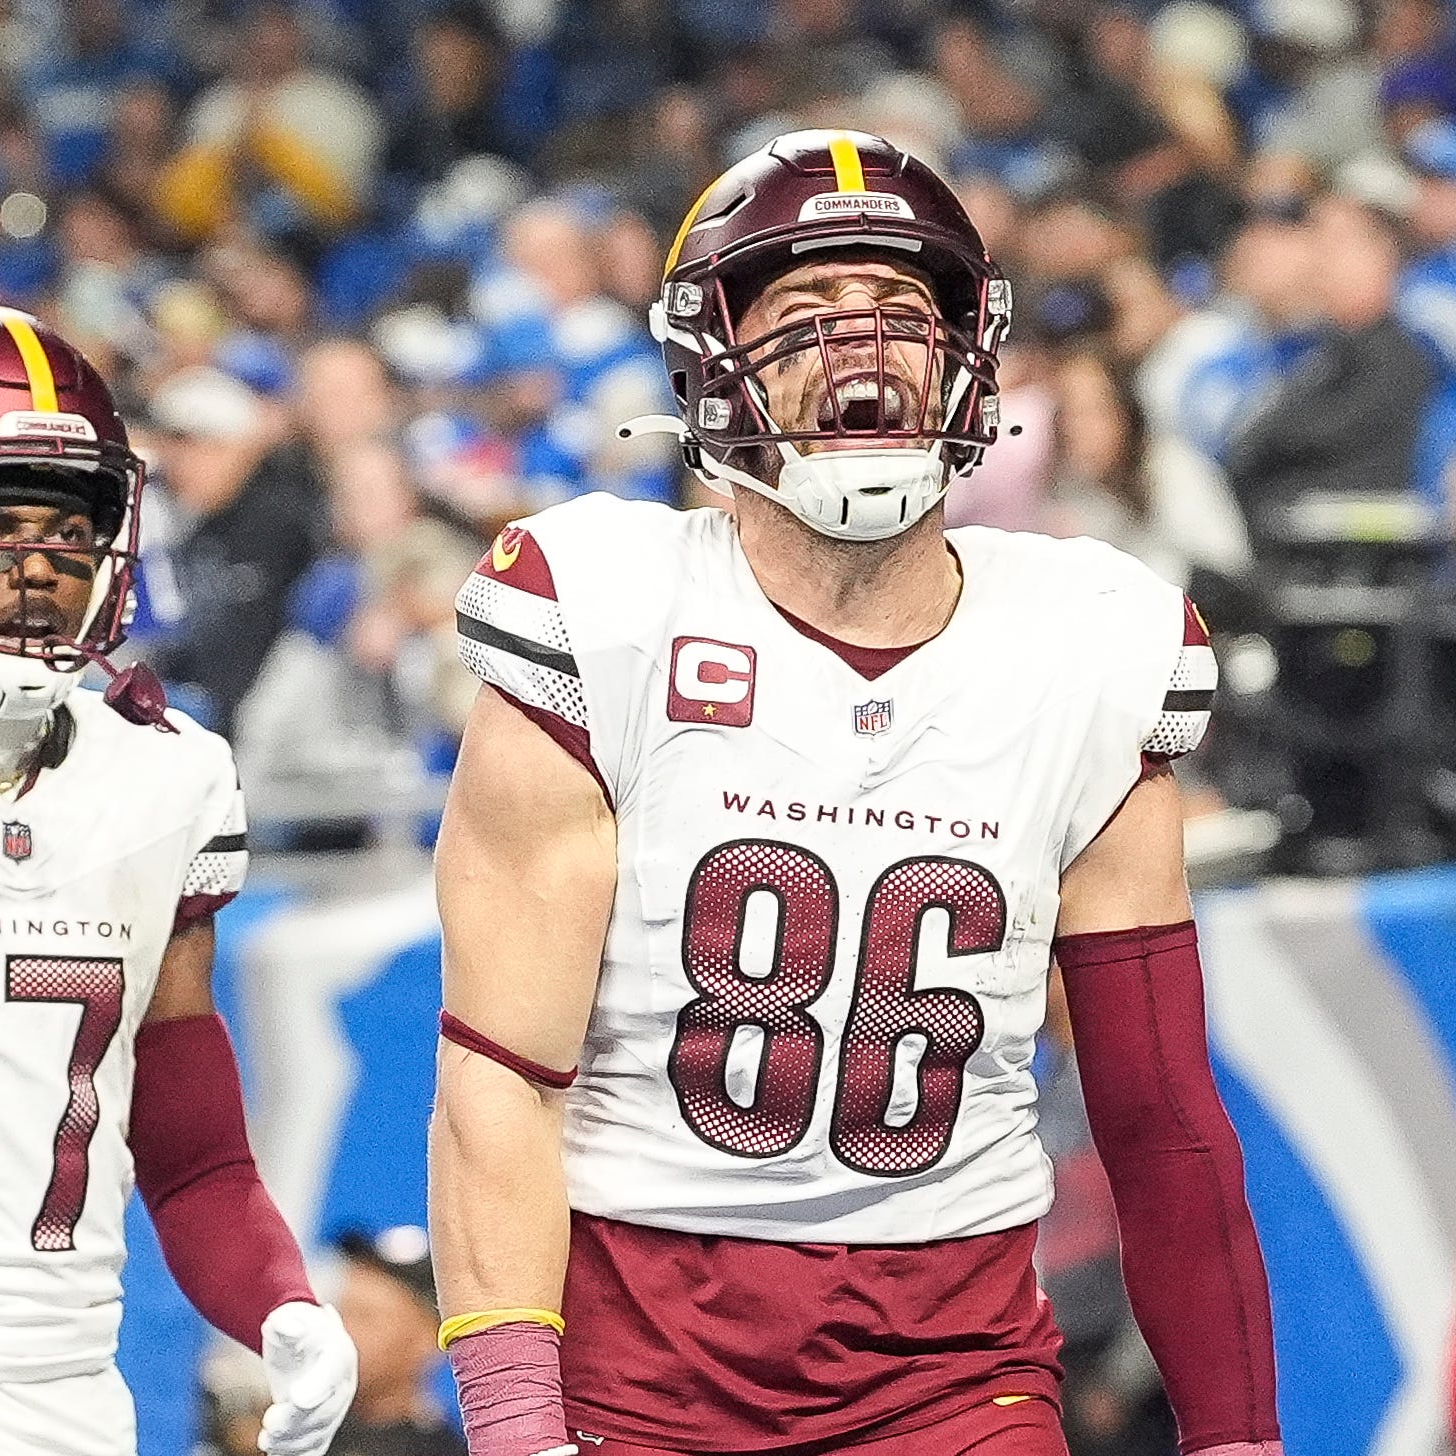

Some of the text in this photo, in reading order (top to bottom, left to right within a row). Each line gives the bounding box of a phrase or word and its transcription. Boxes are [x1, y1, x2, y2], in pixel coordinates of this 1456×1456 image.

[814, 199, 901, 211] COMMANDERS
[674, 641, 751, 704] C
[858, 713, 889, 732] NFL
[722, 791, 1000, 840] WASHINGTON
[667, 837, 1007, 1177] 86
